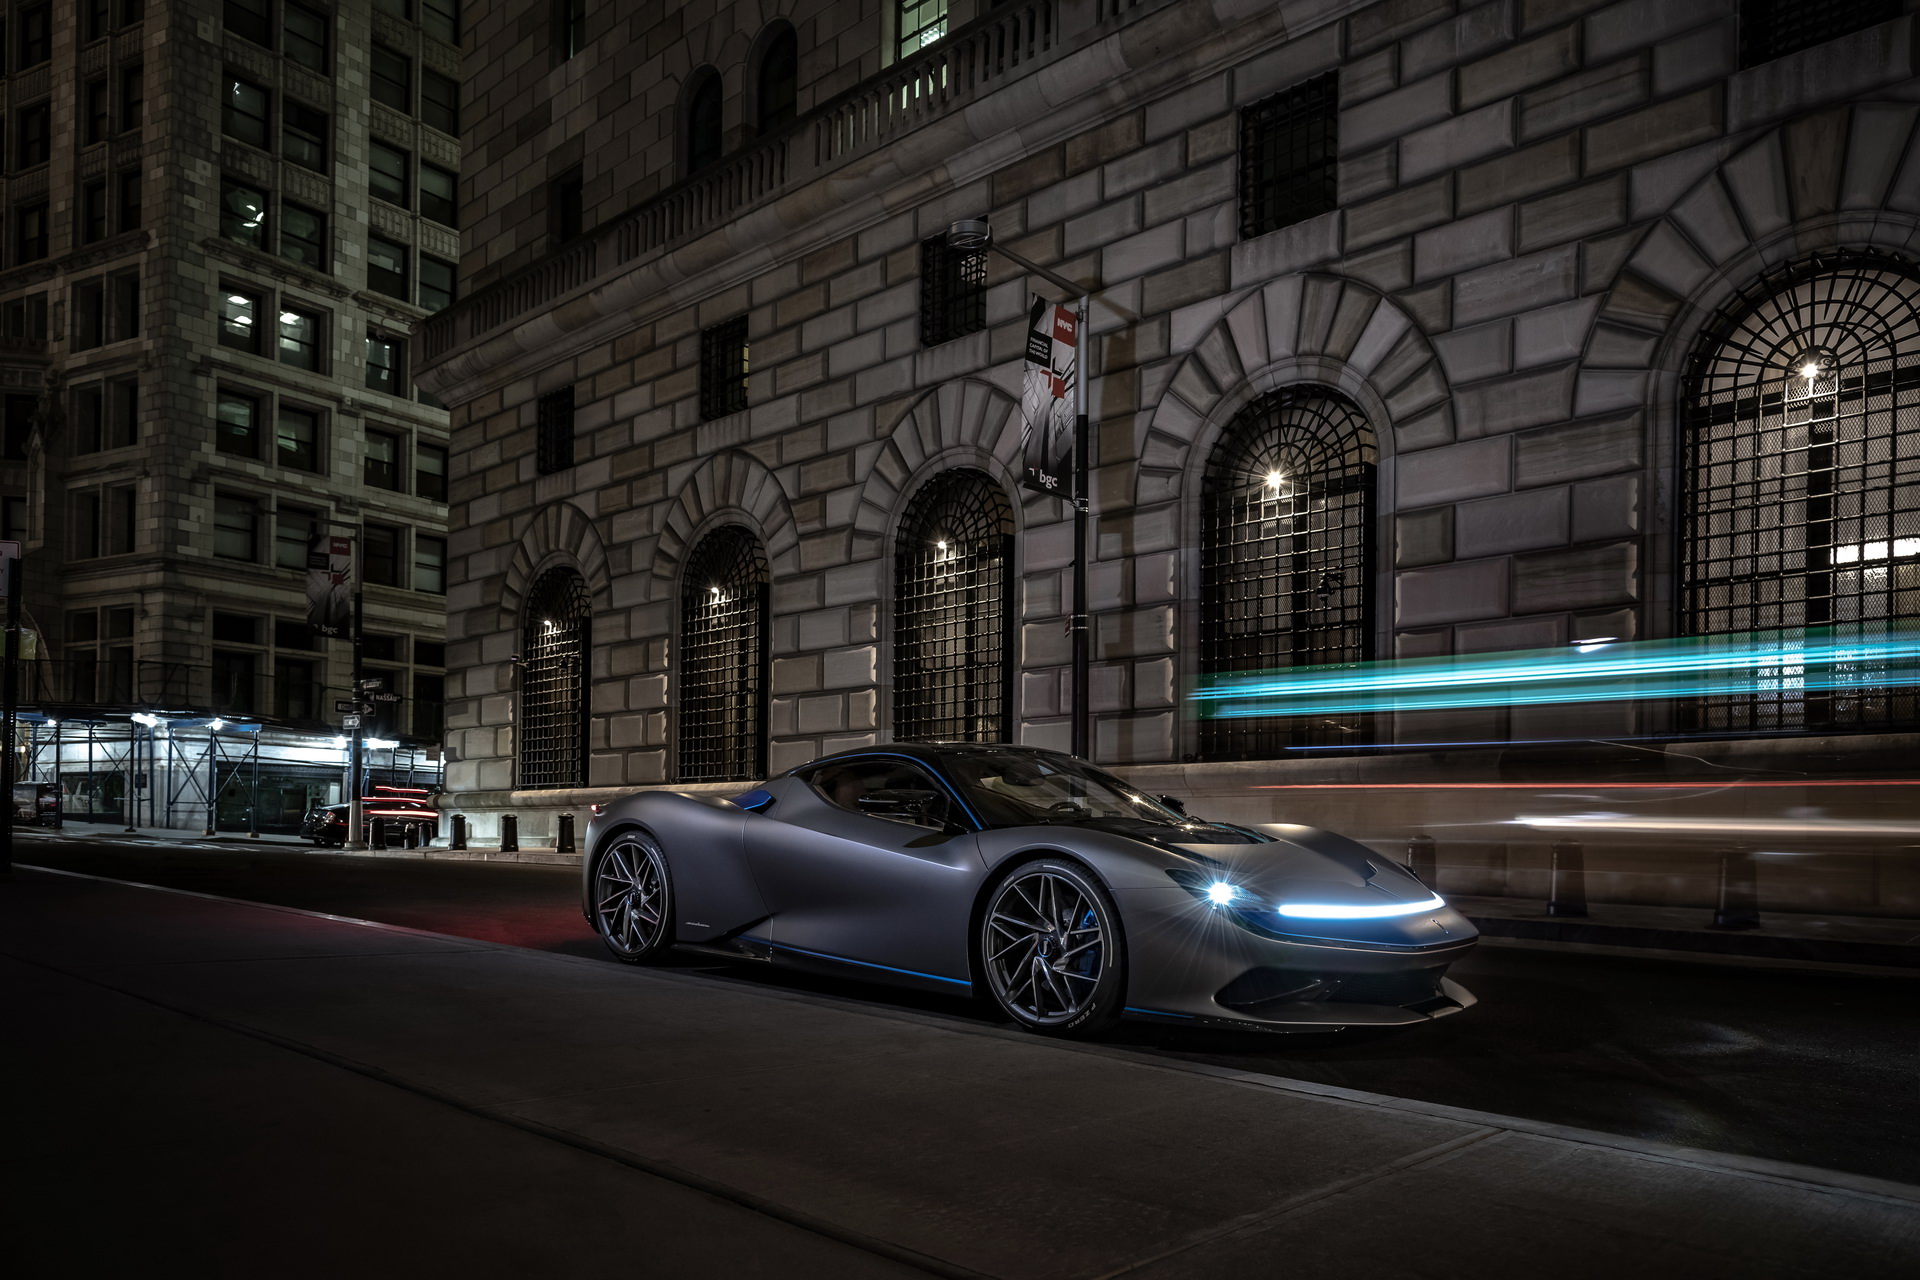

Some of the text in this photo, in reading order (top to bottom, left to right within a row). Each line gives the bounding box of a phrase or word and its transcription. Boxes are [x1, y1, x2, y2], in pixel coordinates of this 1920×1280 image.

[1057, 318, 1072, 332] NYC
[1029, 343, 1043, 352] CAPITAL
[1030, 337, 1048, 348] FINANCIAL
[1039, 469, 1057, 489] bgc
[322, 624, 338, 634] bgc
[375, 694, 397, 702] NASSAU
[1068, 1009, 1091, 1028] ZERO
